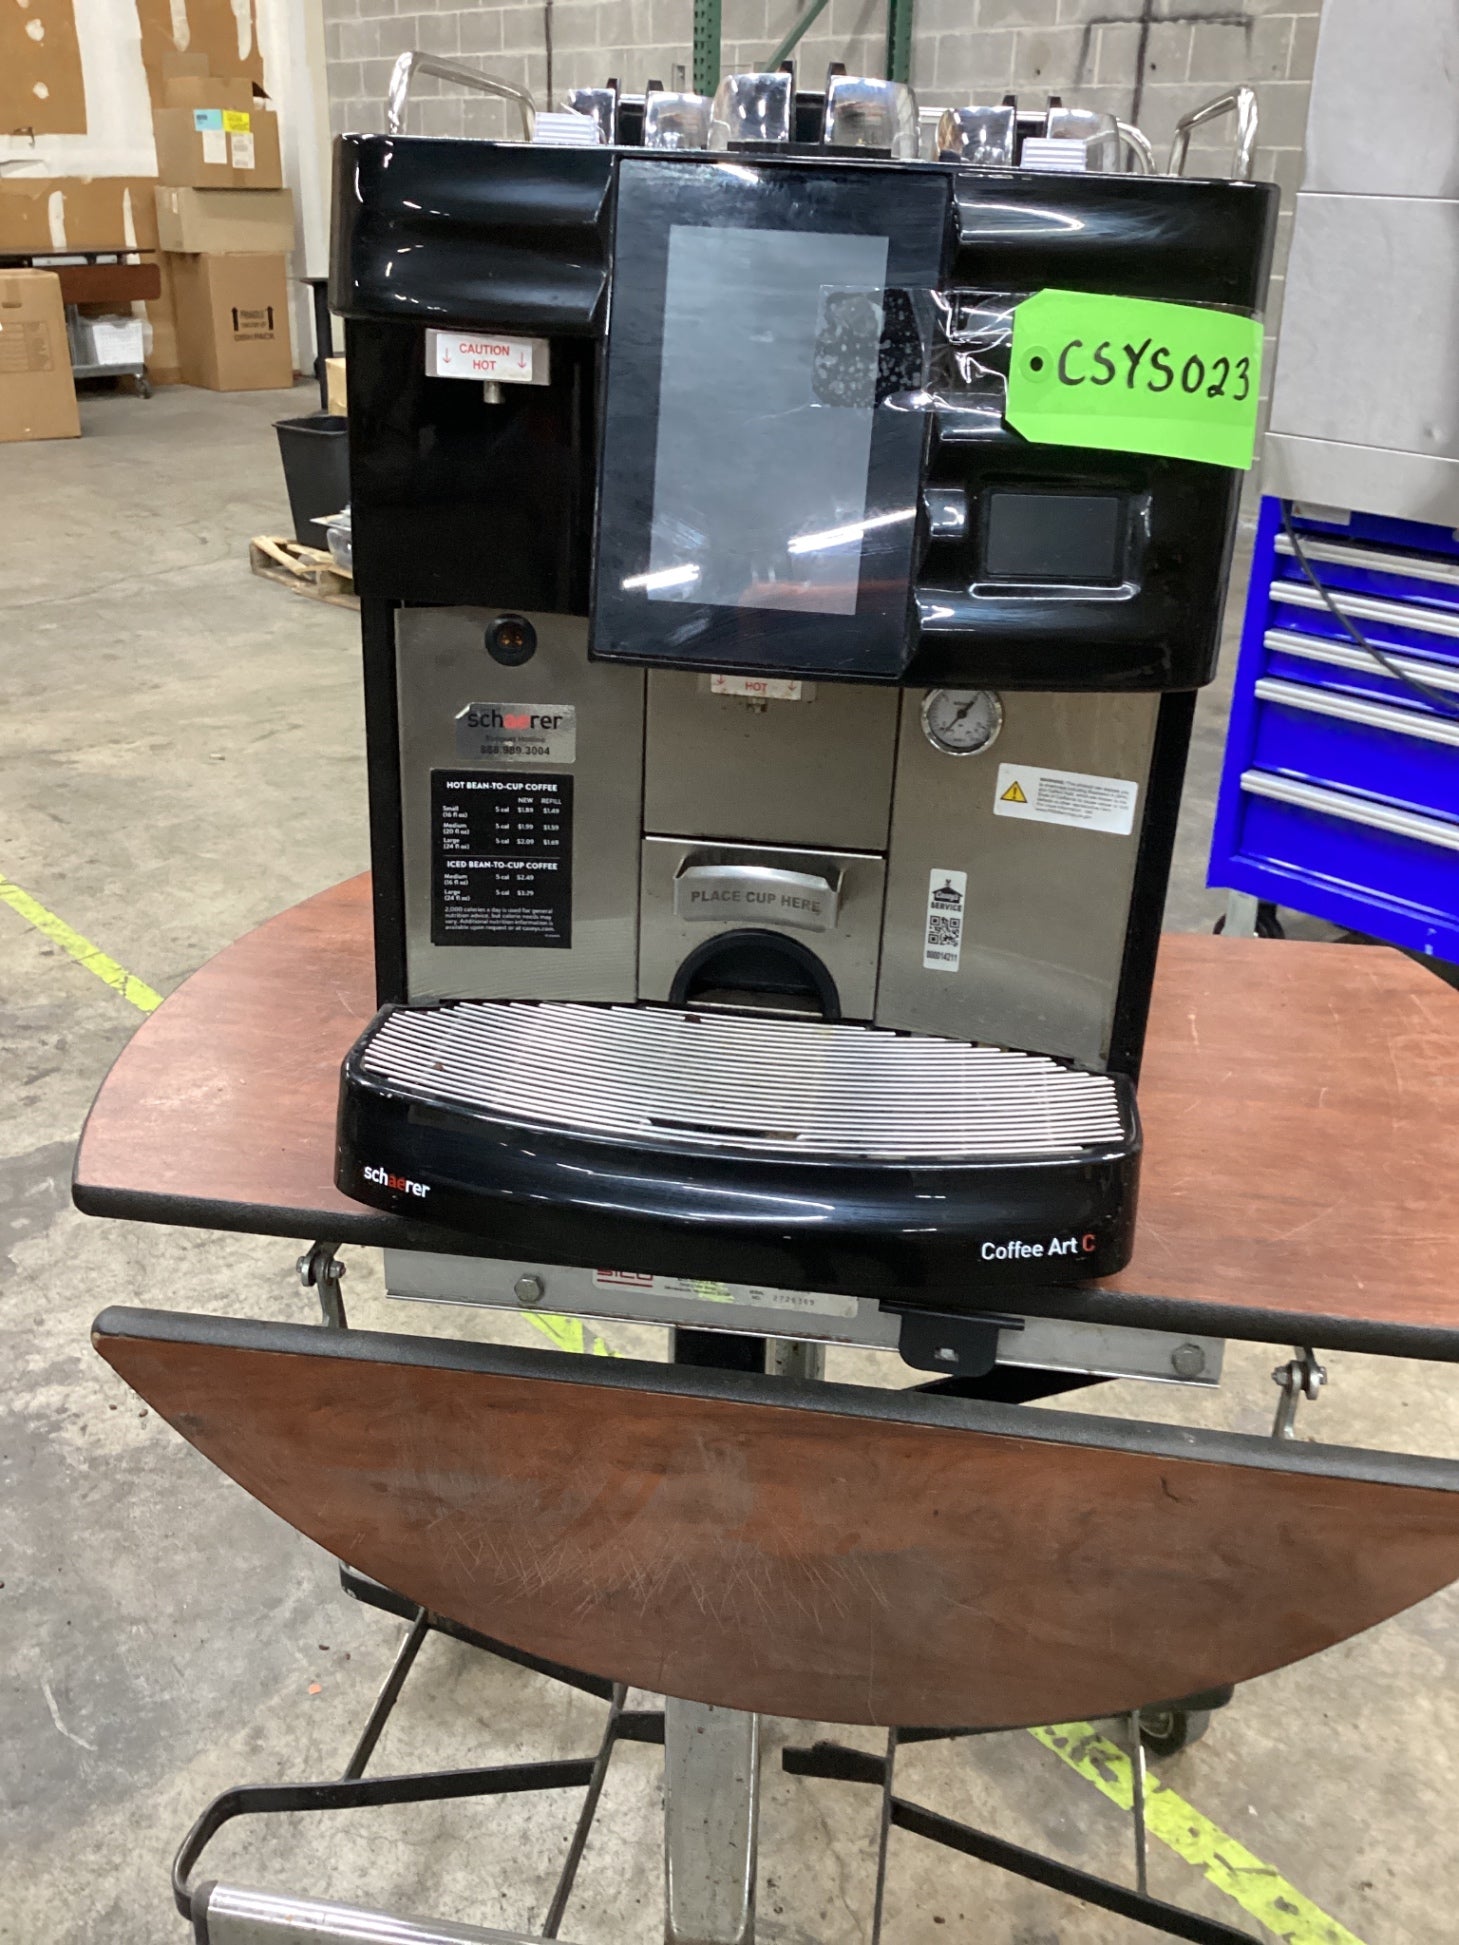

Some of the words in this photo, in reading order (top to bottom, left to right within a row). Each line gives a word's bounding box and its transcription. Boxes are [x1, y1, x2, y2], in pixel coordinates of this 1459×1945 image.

[459, 343, 510, 356] CAUTION
[472, 360, 496, 370] HOT
[745, 682, 768, 691] HOT
[467, 709, 563, 730] schaerer
[446, 781, 465, 789] HOT
[466, 782, 524, 790] BEAN-TO-CUP
[525, 783, 558, 792] COFFEE
[468, 861, 525, 869] BEAN-TO-CUP
[526, 862, 558, 870] COFFEE
[691, 890, 741, 902] PLACE
[745, 891, 776, 904] CUP
[781, 896, 823, 913] HERE
[930, 902, 962, 912] SERVICE
[363, 1166, 431, 1198] schaerer
[981, 1240, 1044, 1260] Coffee
[1047, 1237, 1078, 1255] Art
[1082, 1234, 1096, 1251] C
